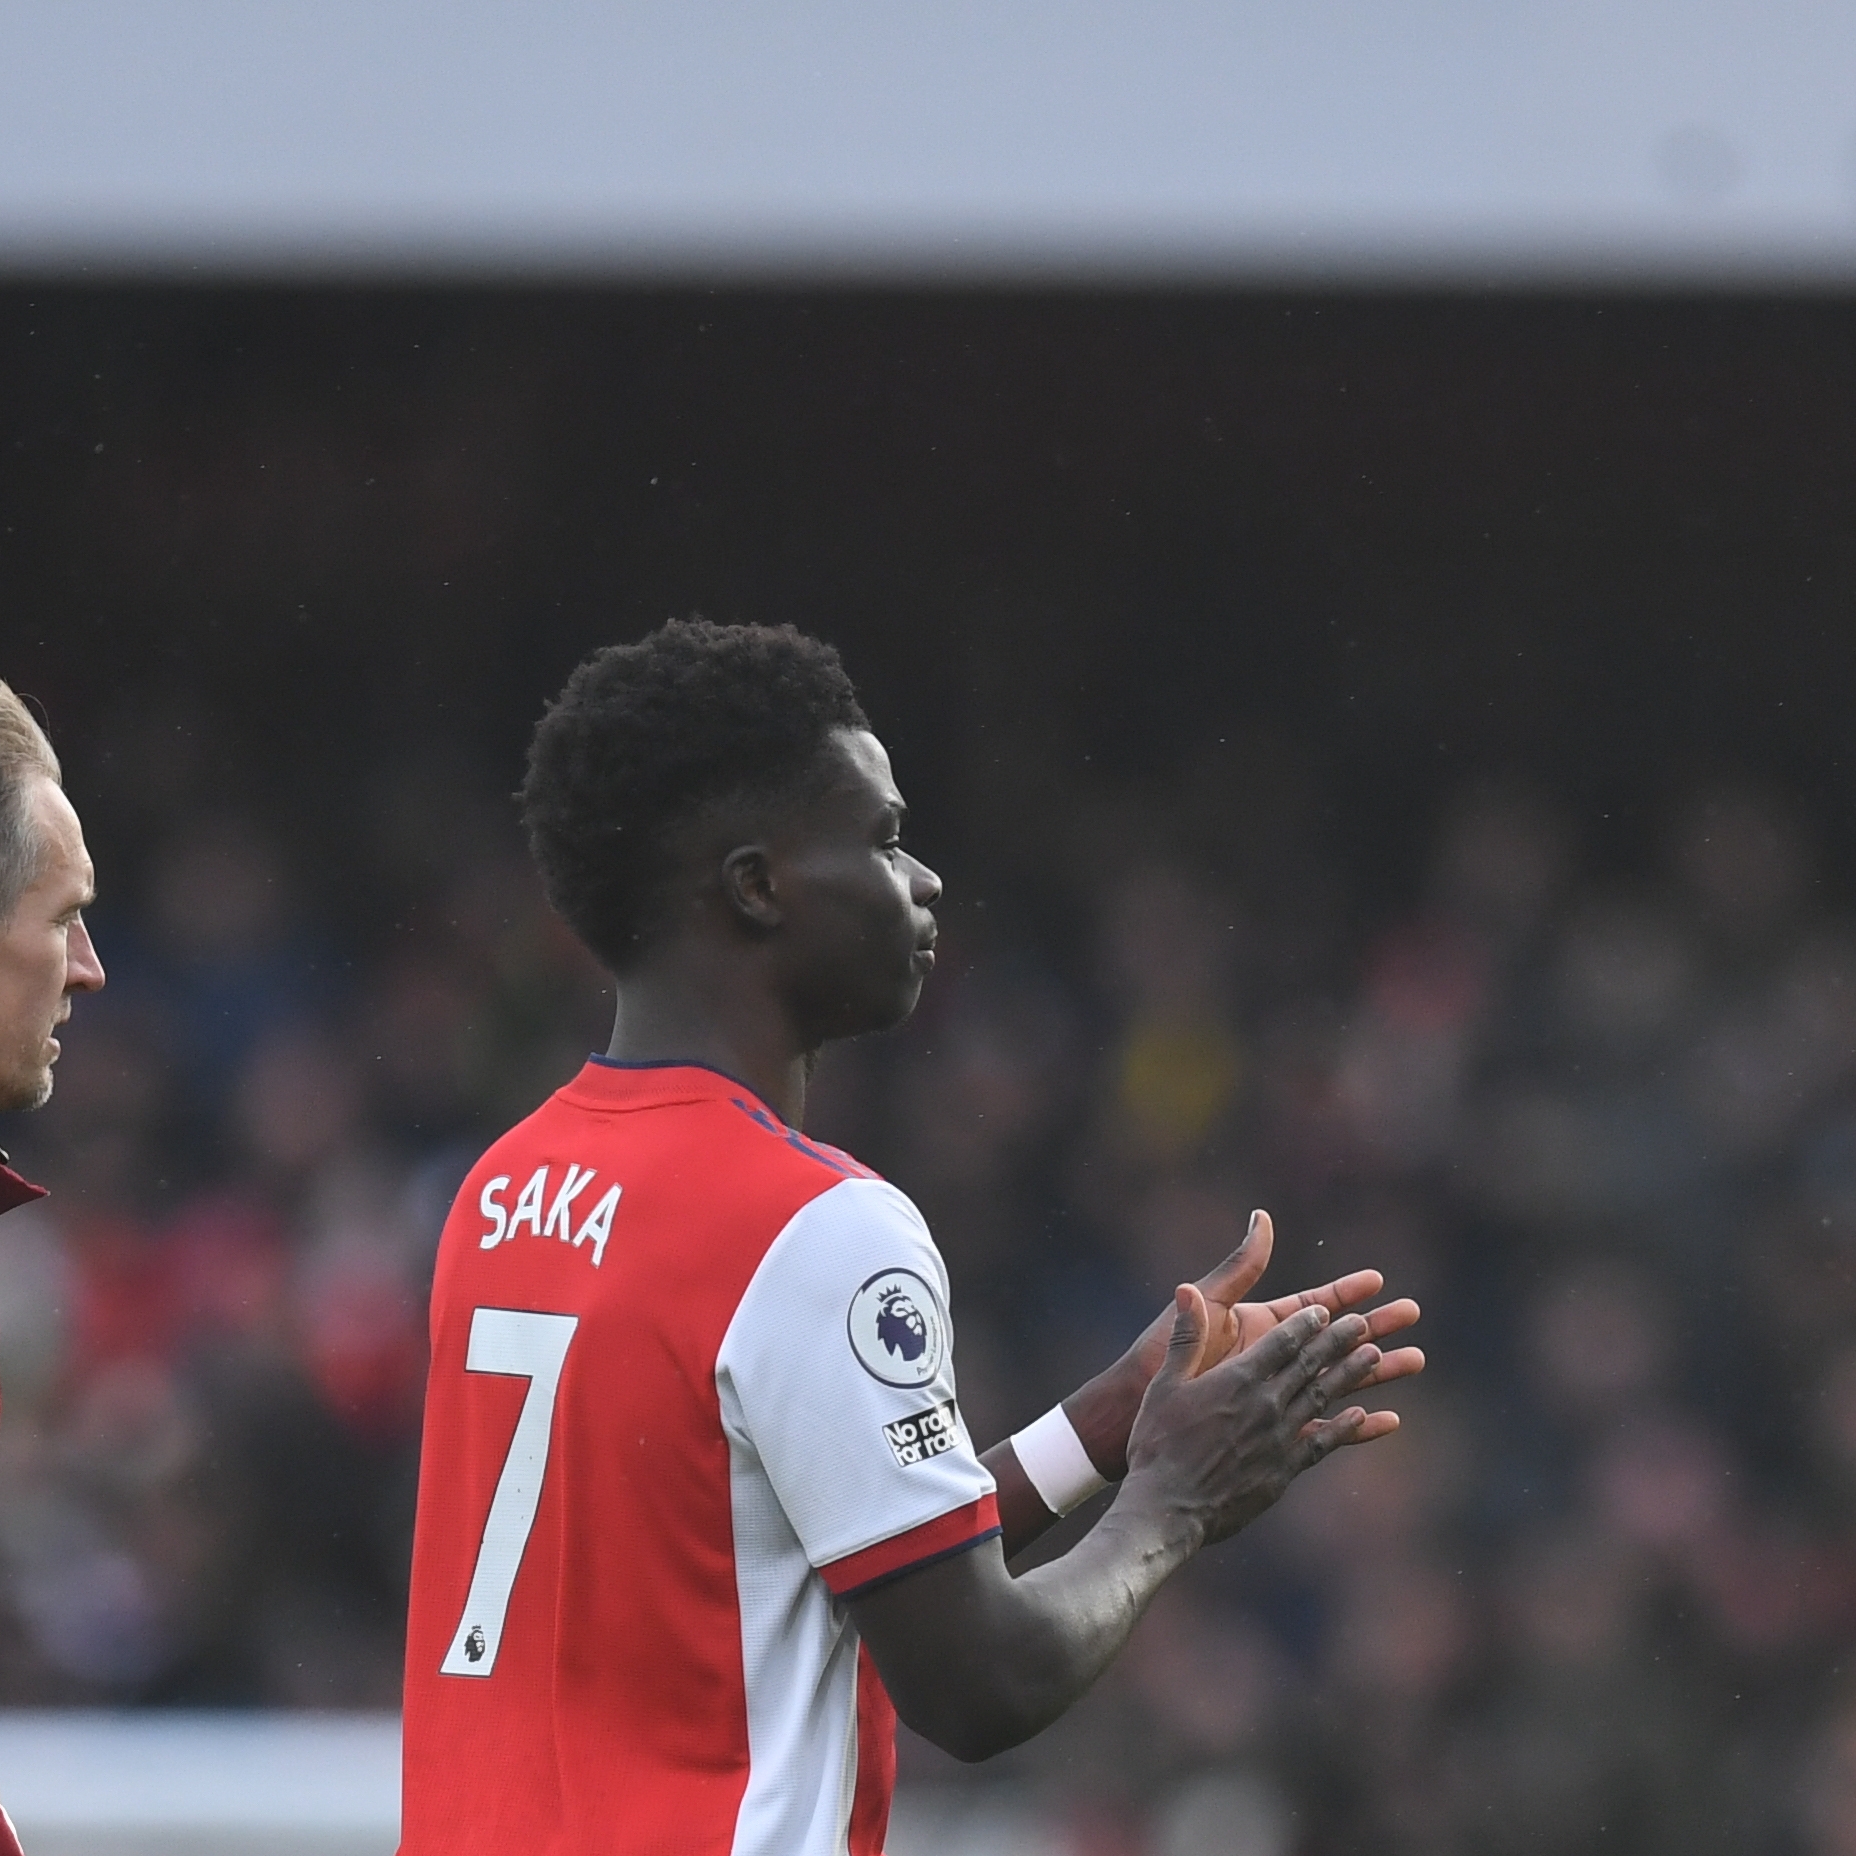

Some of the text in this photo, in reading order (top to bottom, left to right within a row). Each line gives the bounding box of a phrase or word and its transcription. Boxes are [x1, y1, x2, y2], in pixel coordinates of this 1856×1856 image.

[478, 1163, 624, 1270] SAKA
[884, 1422, 918, 1446] No
[893, 1441, 923, 1467] for
[439, 1305, 579, 1678] 7
